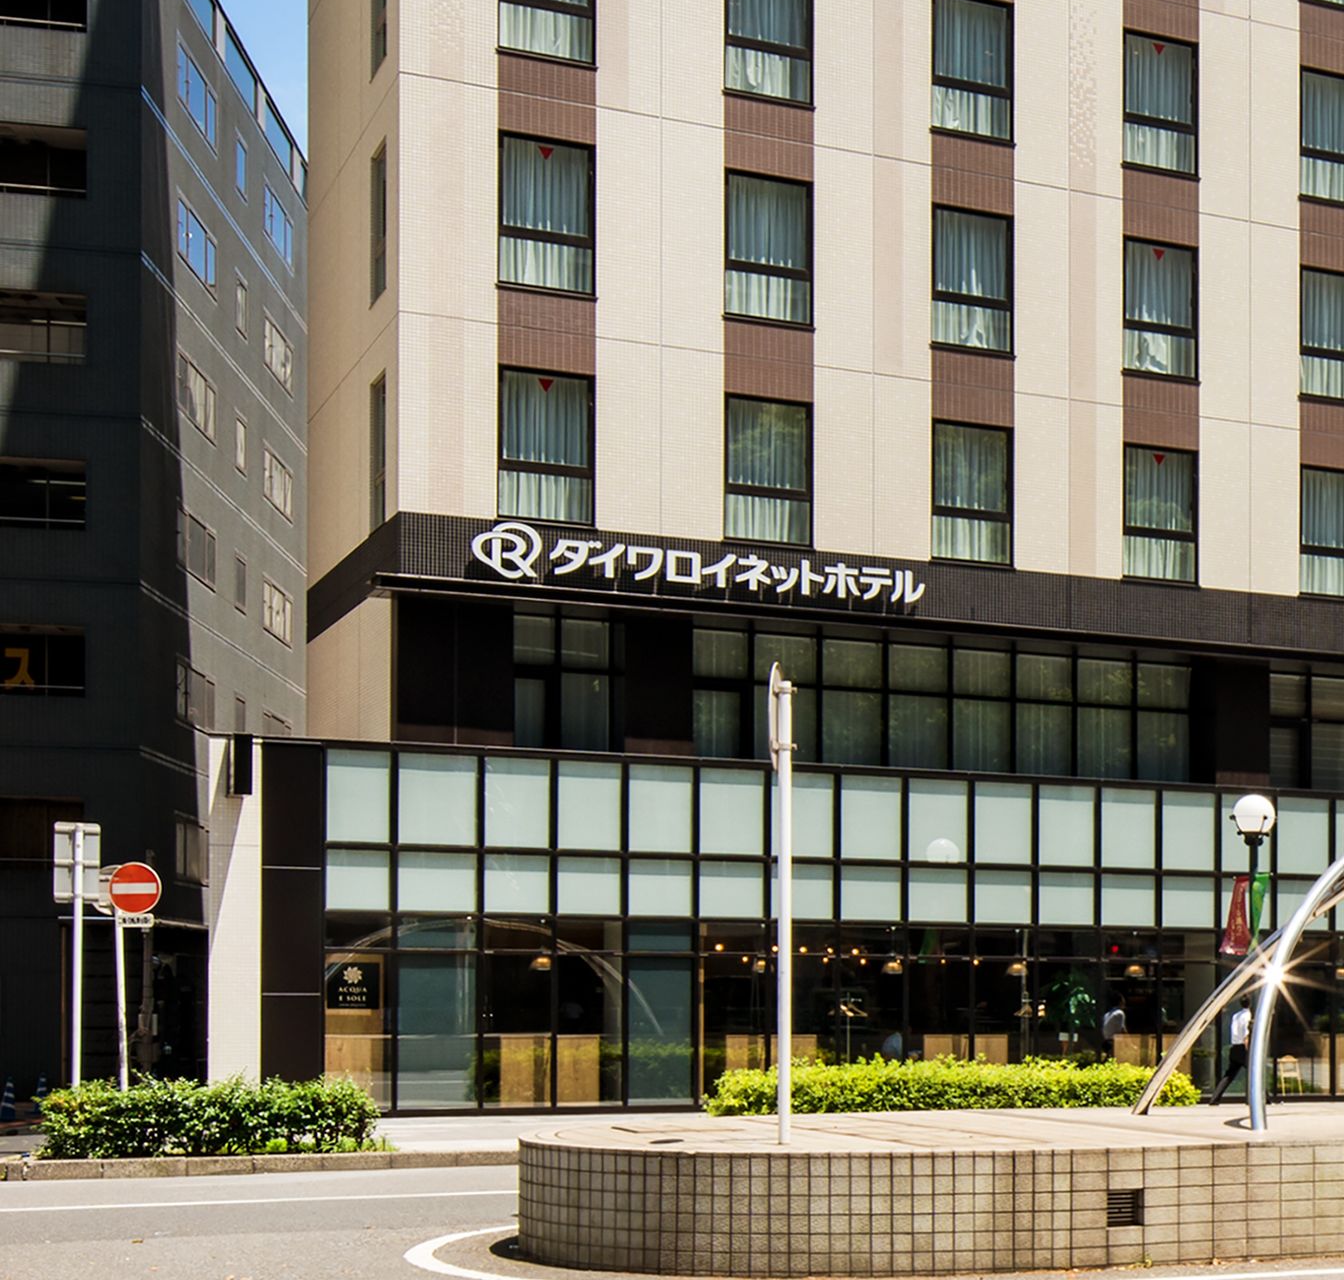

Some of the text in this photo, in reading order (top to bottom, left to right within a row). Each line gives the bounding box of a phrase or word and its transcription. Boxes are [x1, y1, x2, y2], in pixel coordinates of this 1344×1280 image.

[549, 538, 926, 604] ダイワロイネットホテル
[338, 986, 368, 994] ACQUA
